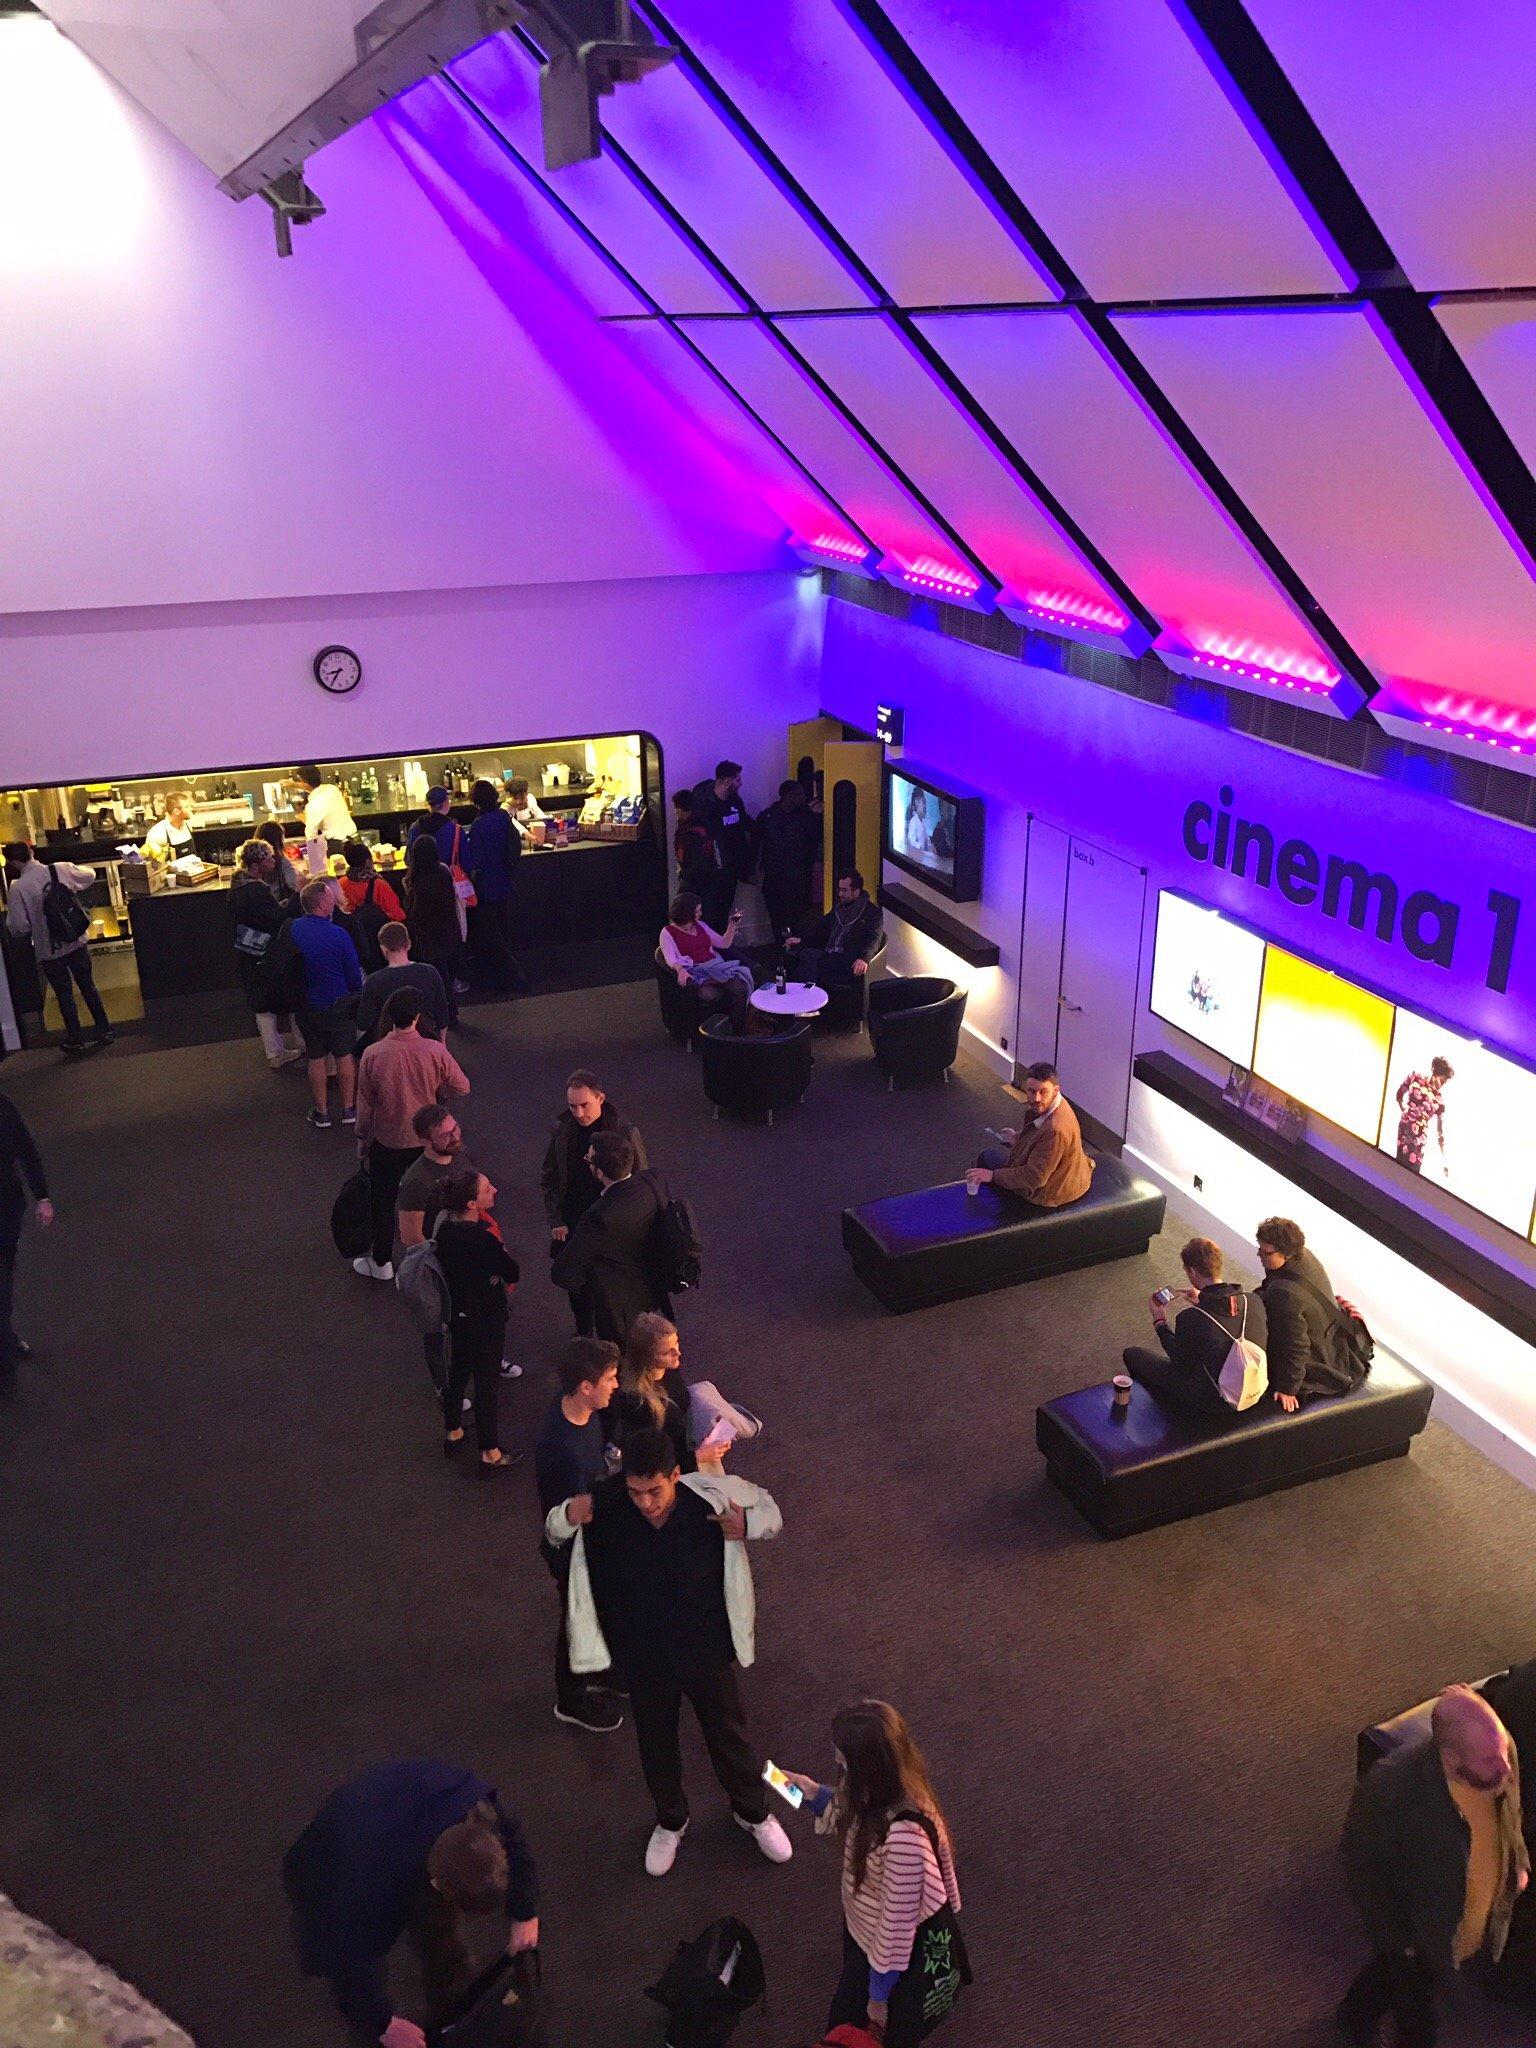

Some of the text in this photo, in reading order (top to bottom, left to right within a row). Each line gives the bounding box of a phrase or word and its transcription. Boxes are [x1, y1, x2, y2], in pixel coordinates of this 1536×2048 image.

[1074, 847, 1088, 863] box
[1182, 784, 1521, 995] cinema 1
